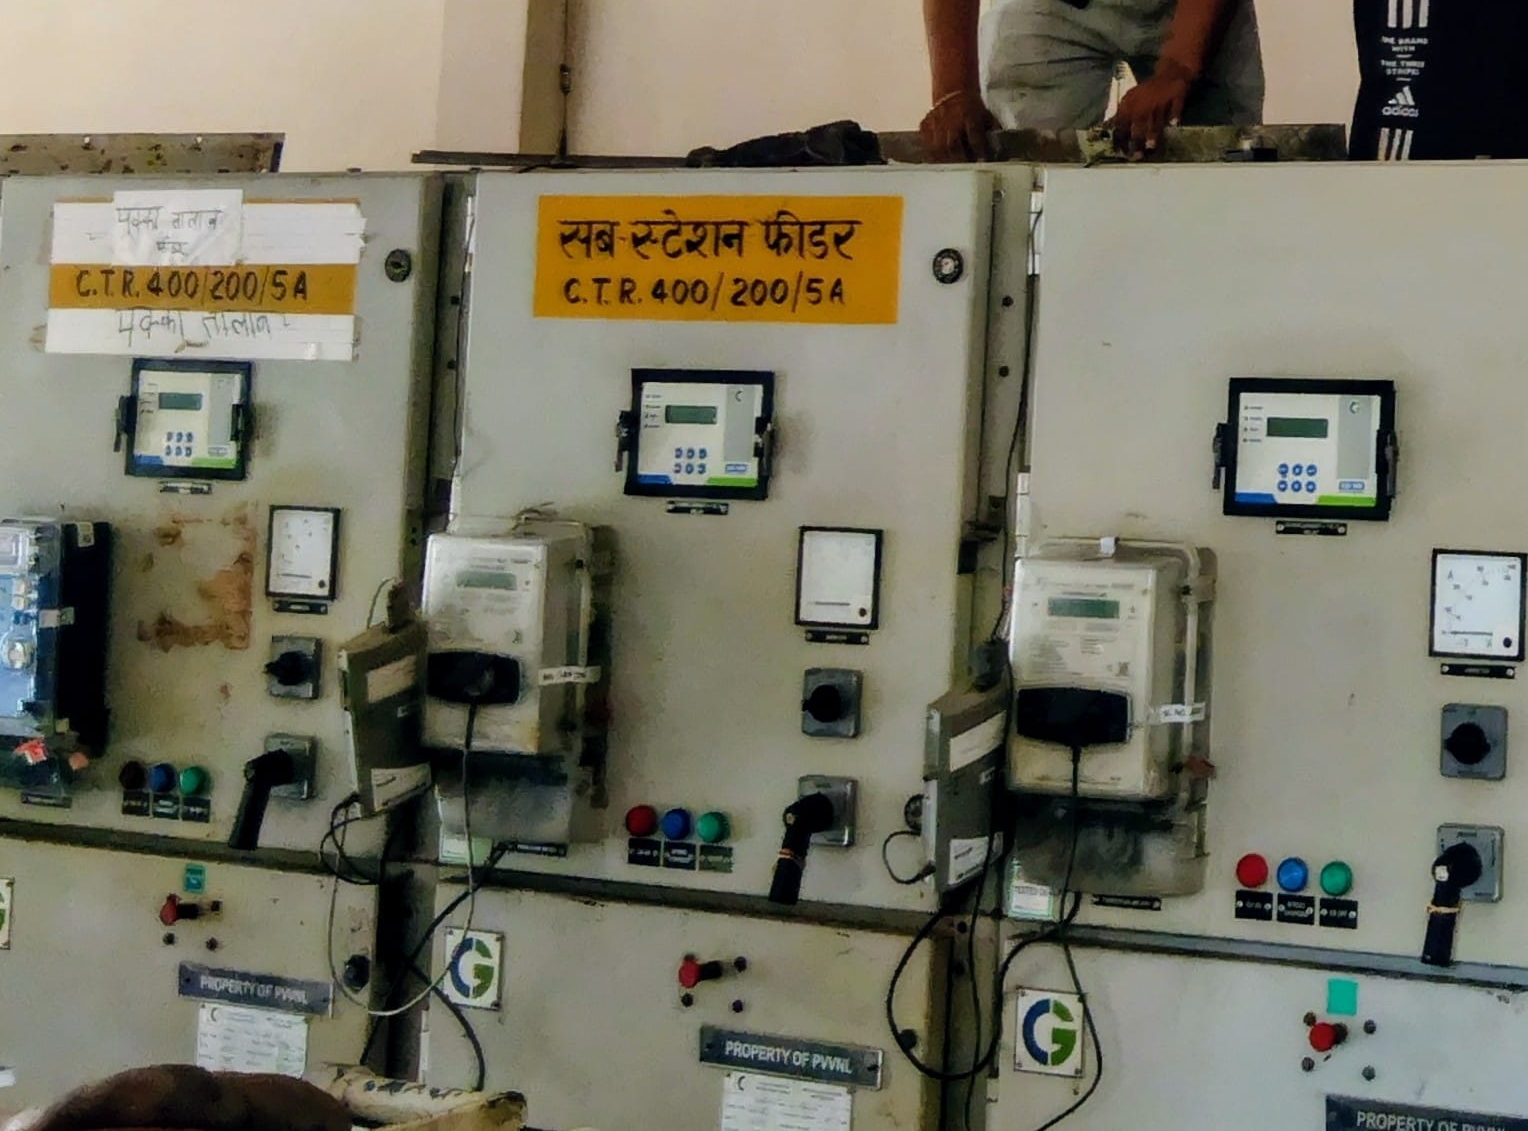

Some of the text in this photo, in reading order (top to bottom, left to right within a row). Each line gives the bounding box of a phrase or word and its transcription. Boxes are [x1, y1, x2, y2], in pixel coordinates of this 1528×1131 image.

[756, 209, 863, 261] फीडर
[200, 974, 255, 995] PROPERTY
[257, 982, 273, 998] OF
[725, 1040, 792, 1065] PROPERTY
[792, 1050, 810, 1067] OF
